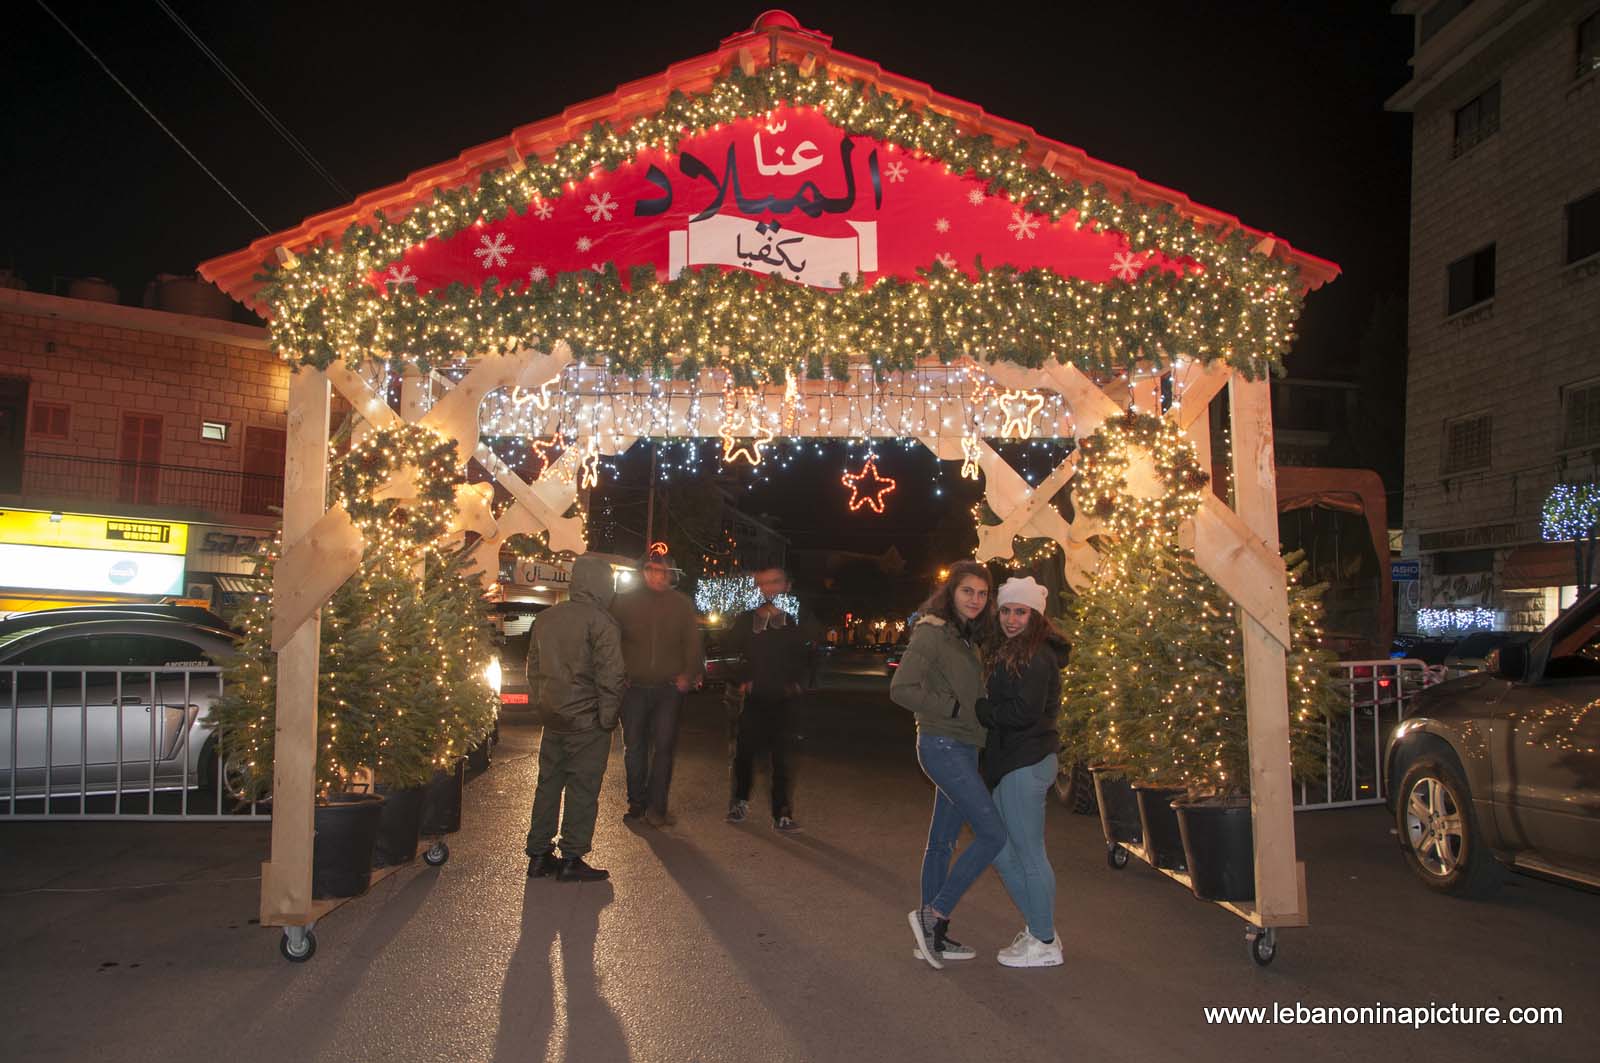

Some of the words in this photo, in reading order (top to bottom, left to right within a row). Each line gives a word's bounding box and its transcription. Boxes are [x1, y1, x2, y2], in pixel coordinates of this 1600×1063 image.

[634, 135, 882, 233] الميلاد
[736, 233, 807, 281] بكفيا
[109, 522, 162, 533] WESTERN
[123, 531, 161, 542] UNION
[1391, 565, 1418, 574] ASIO
